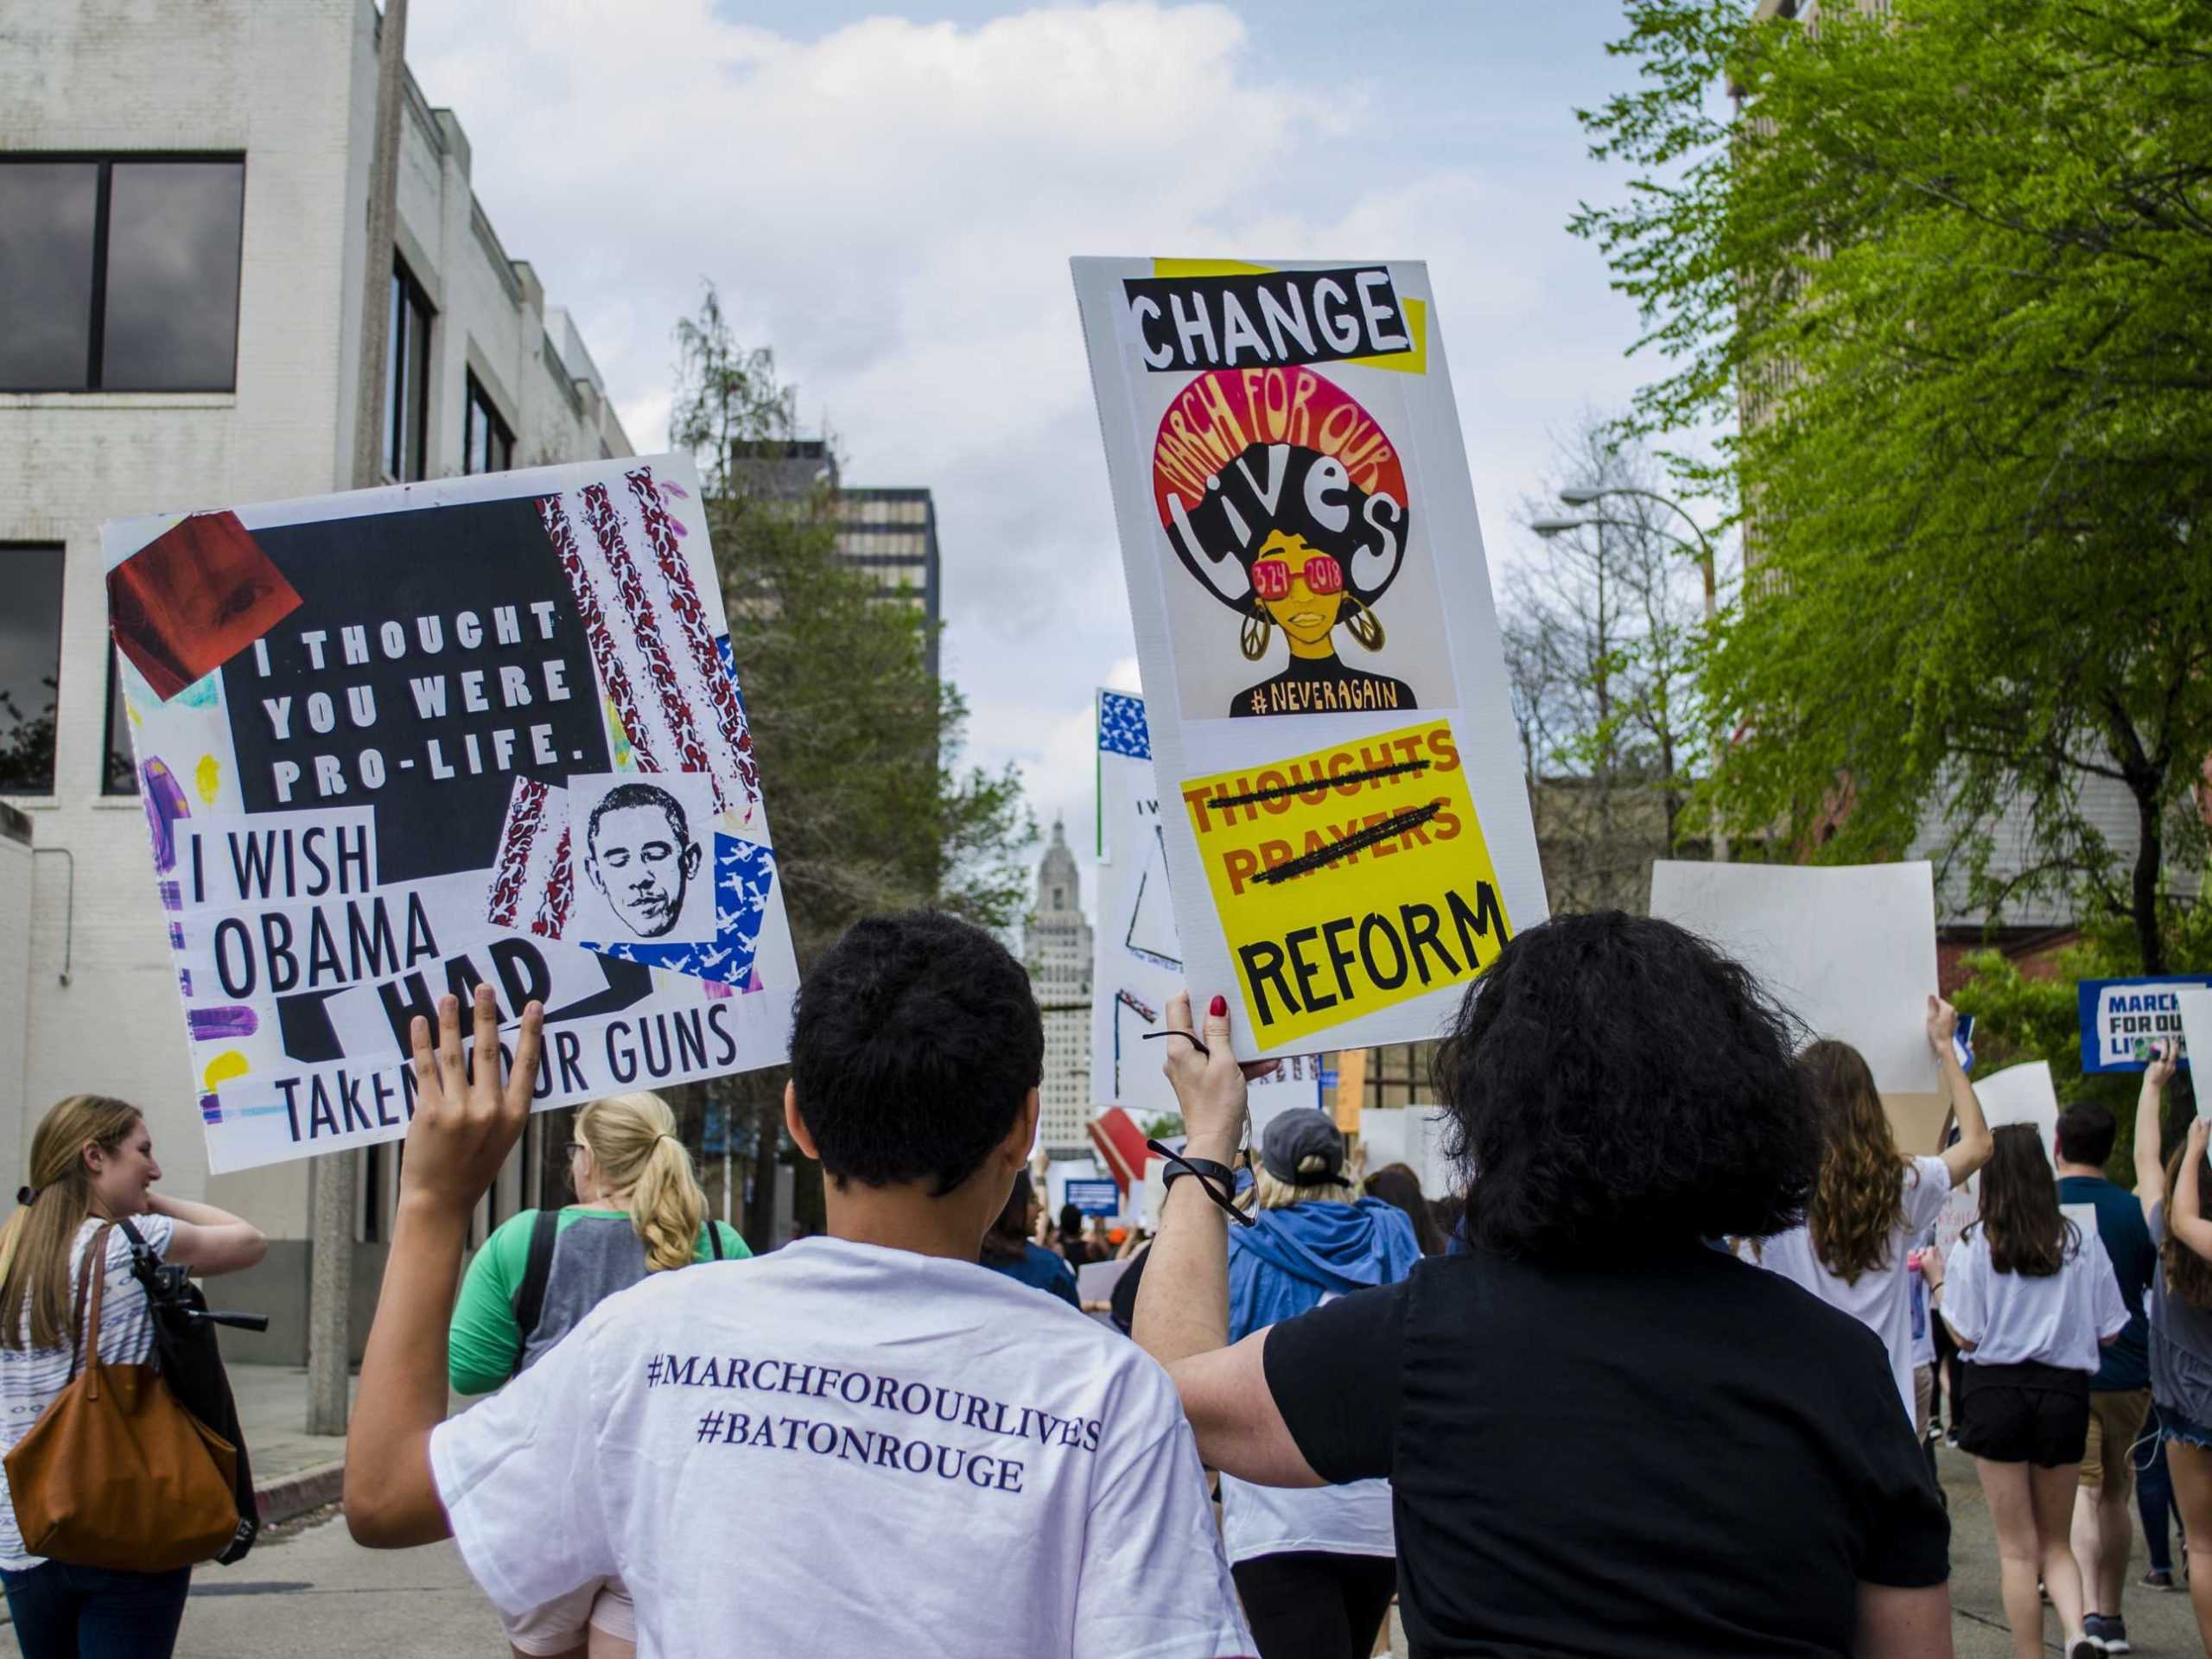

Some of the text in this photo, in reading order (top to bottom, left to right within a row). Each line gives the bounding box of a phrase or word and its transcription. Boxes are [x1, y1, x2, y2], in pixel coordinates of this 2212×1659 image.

[1129, 271, 1411, 368] CHANGE
[1155, 366, 1392, 501] MARCH FOR OUR
[1307, 556, 1341, 588] 2018
[253, 600, 556, 677] I THOUGHT
[263, 659, 570, 740] YOU WERE
[272, 724, 584, 803] PRO-LIFE.
[1182, 728, 1461, 834] THOUGHTS
[192, 825, 370, 902] I WISH
[1222, 797, 1462, 896] PRAYERS
[214, 892, 441, 999] OBAMA
[1238, 880, 1510, 1027] REFORM
[378, 937, 551, 1061] HAD
[606, 1002, 738, 1084] GUNS
[2110, 1015, 2152, 1033] FOR
[647, 1353, 1102, 1453] #MARCHFOROURLIVES
[696, 1410, 1025, 1494] #BATONROUGE
